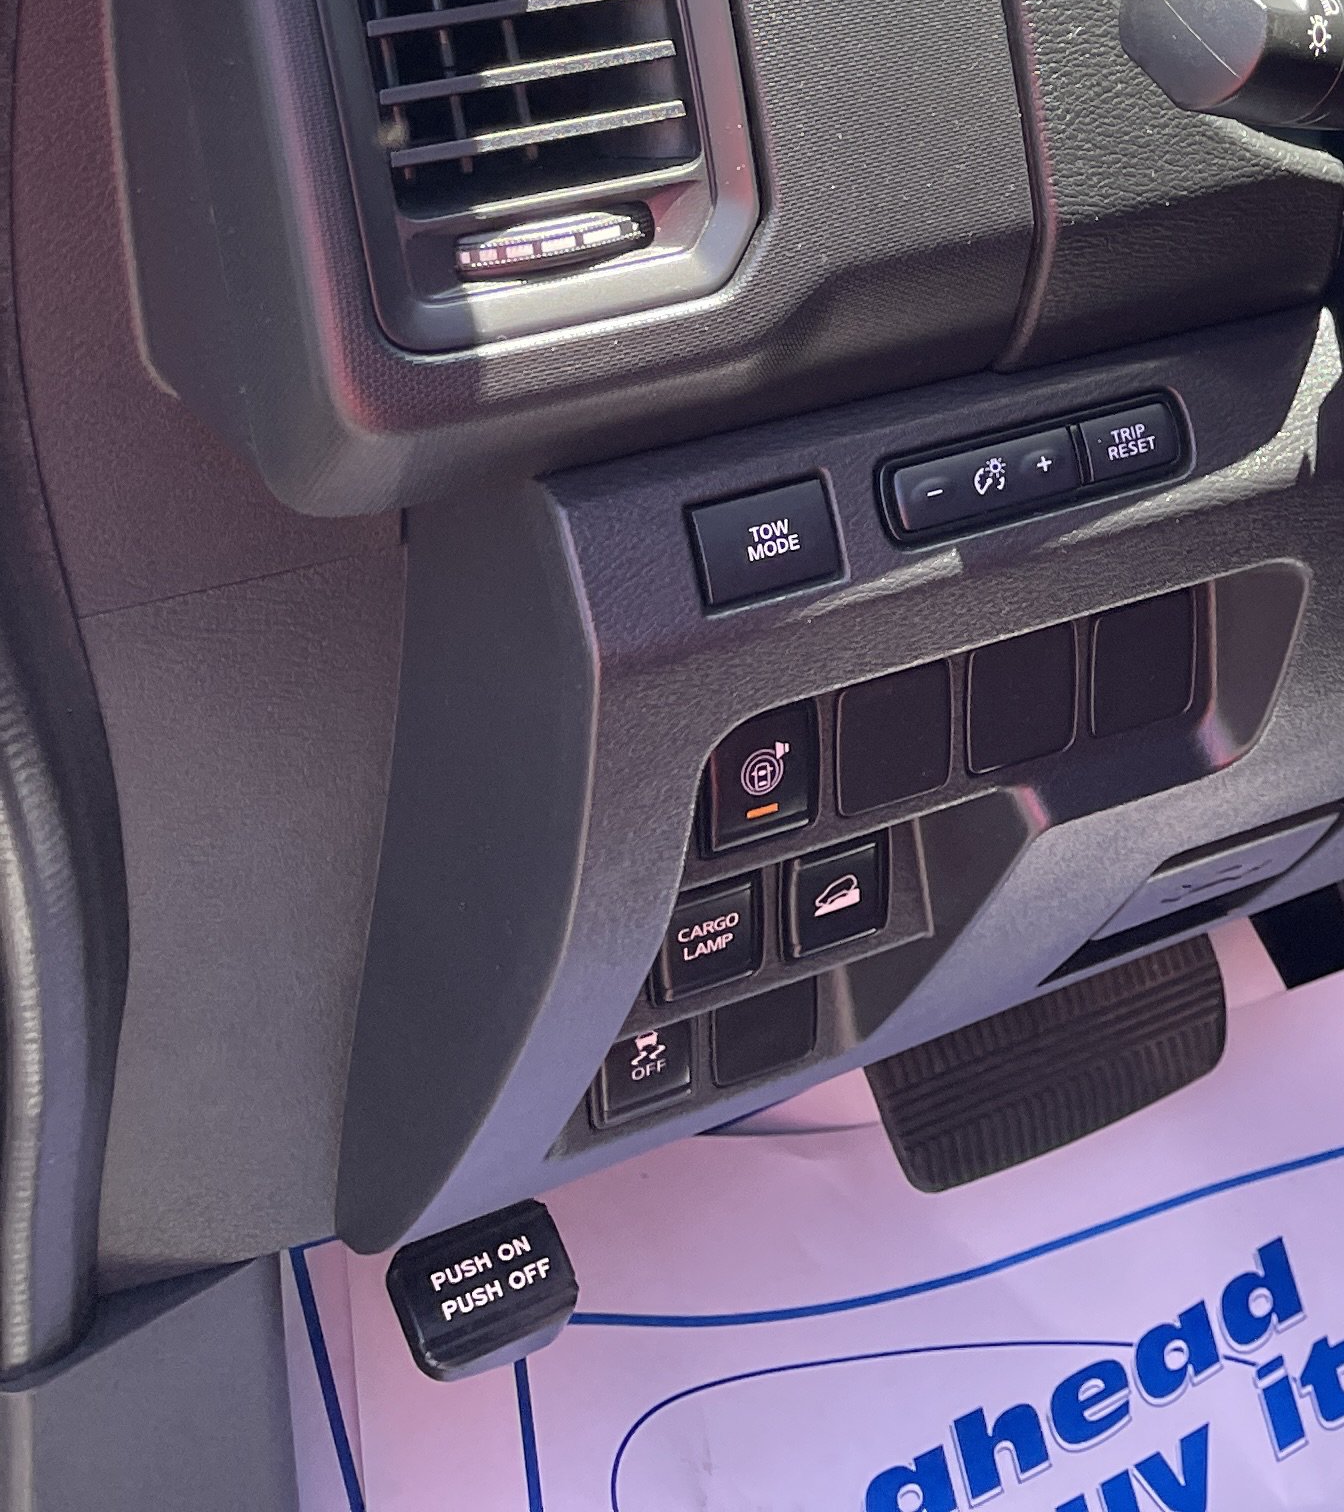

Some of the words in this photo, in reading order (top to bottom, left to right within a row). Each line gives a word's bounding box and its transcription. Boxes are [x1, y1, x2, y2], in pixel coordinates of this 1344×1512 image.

[1107, 435, 1156, 461] RESET
[1110, 422, 1146, 445] TRIP
[748, 518, 791, 544] TOW
[746, 532, 800, 562] MODE
[677, 911, 740, 945] CARGO
[682, 931, 734, 962] LAMP
[630, 1057, 667, 1081] OFF
[430, 1251, 493, 1292] PUSH
[497, 1235, 532, 1261] ON
[441, 1279, 504, 1321] PUSH
[508, 1257, 550, 1290] OFF
[864, 1236, 1306, 1512] ahead
